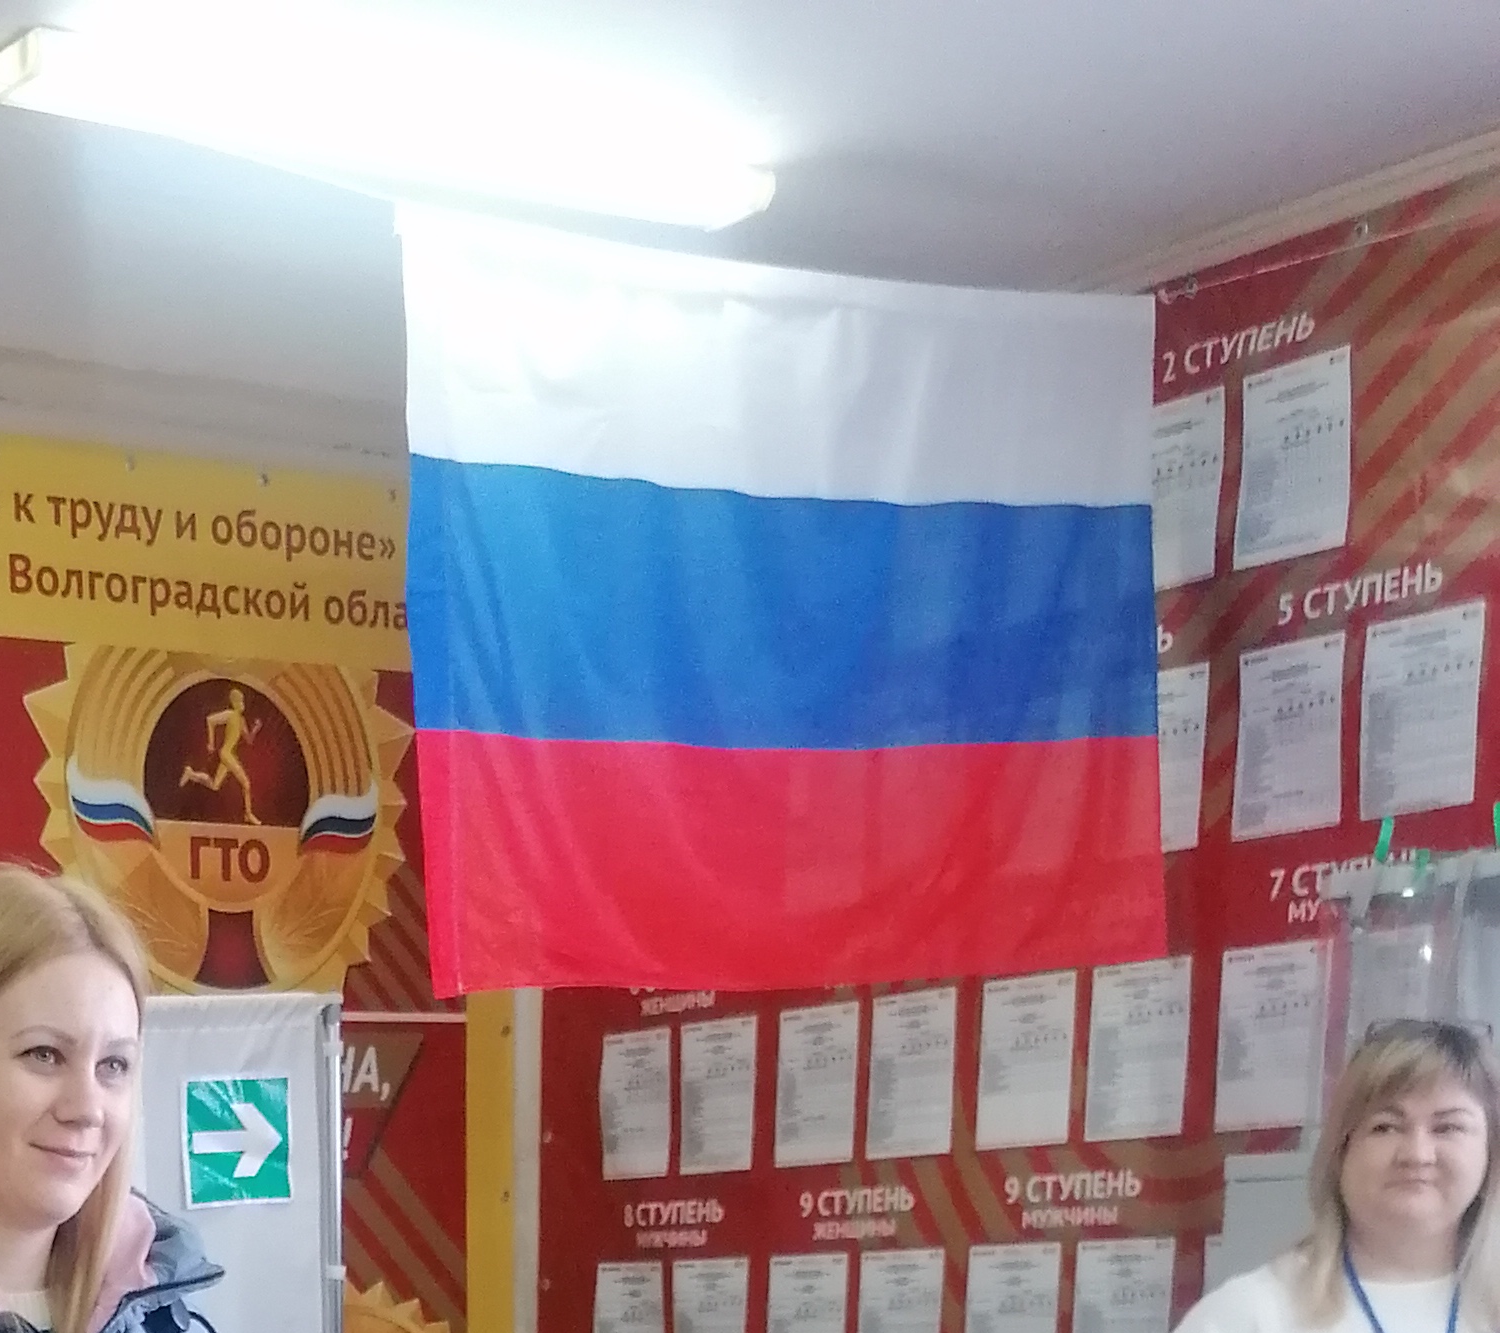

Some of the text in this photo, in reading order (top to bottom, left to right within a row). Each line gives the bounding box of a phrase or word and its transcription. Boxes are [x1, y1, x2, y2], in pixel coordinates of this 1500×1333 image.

[1161, 311, 1316, 384] 2 СТУПЕНЬ
[13, 491, 36, 524] к
[46, 493, 163, 547] труду
[175, 508, 198, 541] и
[211, 509, 397, 562] обороне»
[8, 553, 310, 623] Волгоградской
[1277, 558, 1444, 626] 5 СТУПЕНЬ
[190, 836, 271, 884] ГТО
[1270, 867, 1286, 902] 7
[800, 1185, 916, 1218] 9 СТУПЕНЬ
[1004, 1167, 1142, 1205] 9 СТУПЕНЬ
[636, 1198, 725, 1227] СТУПЕНЬ
